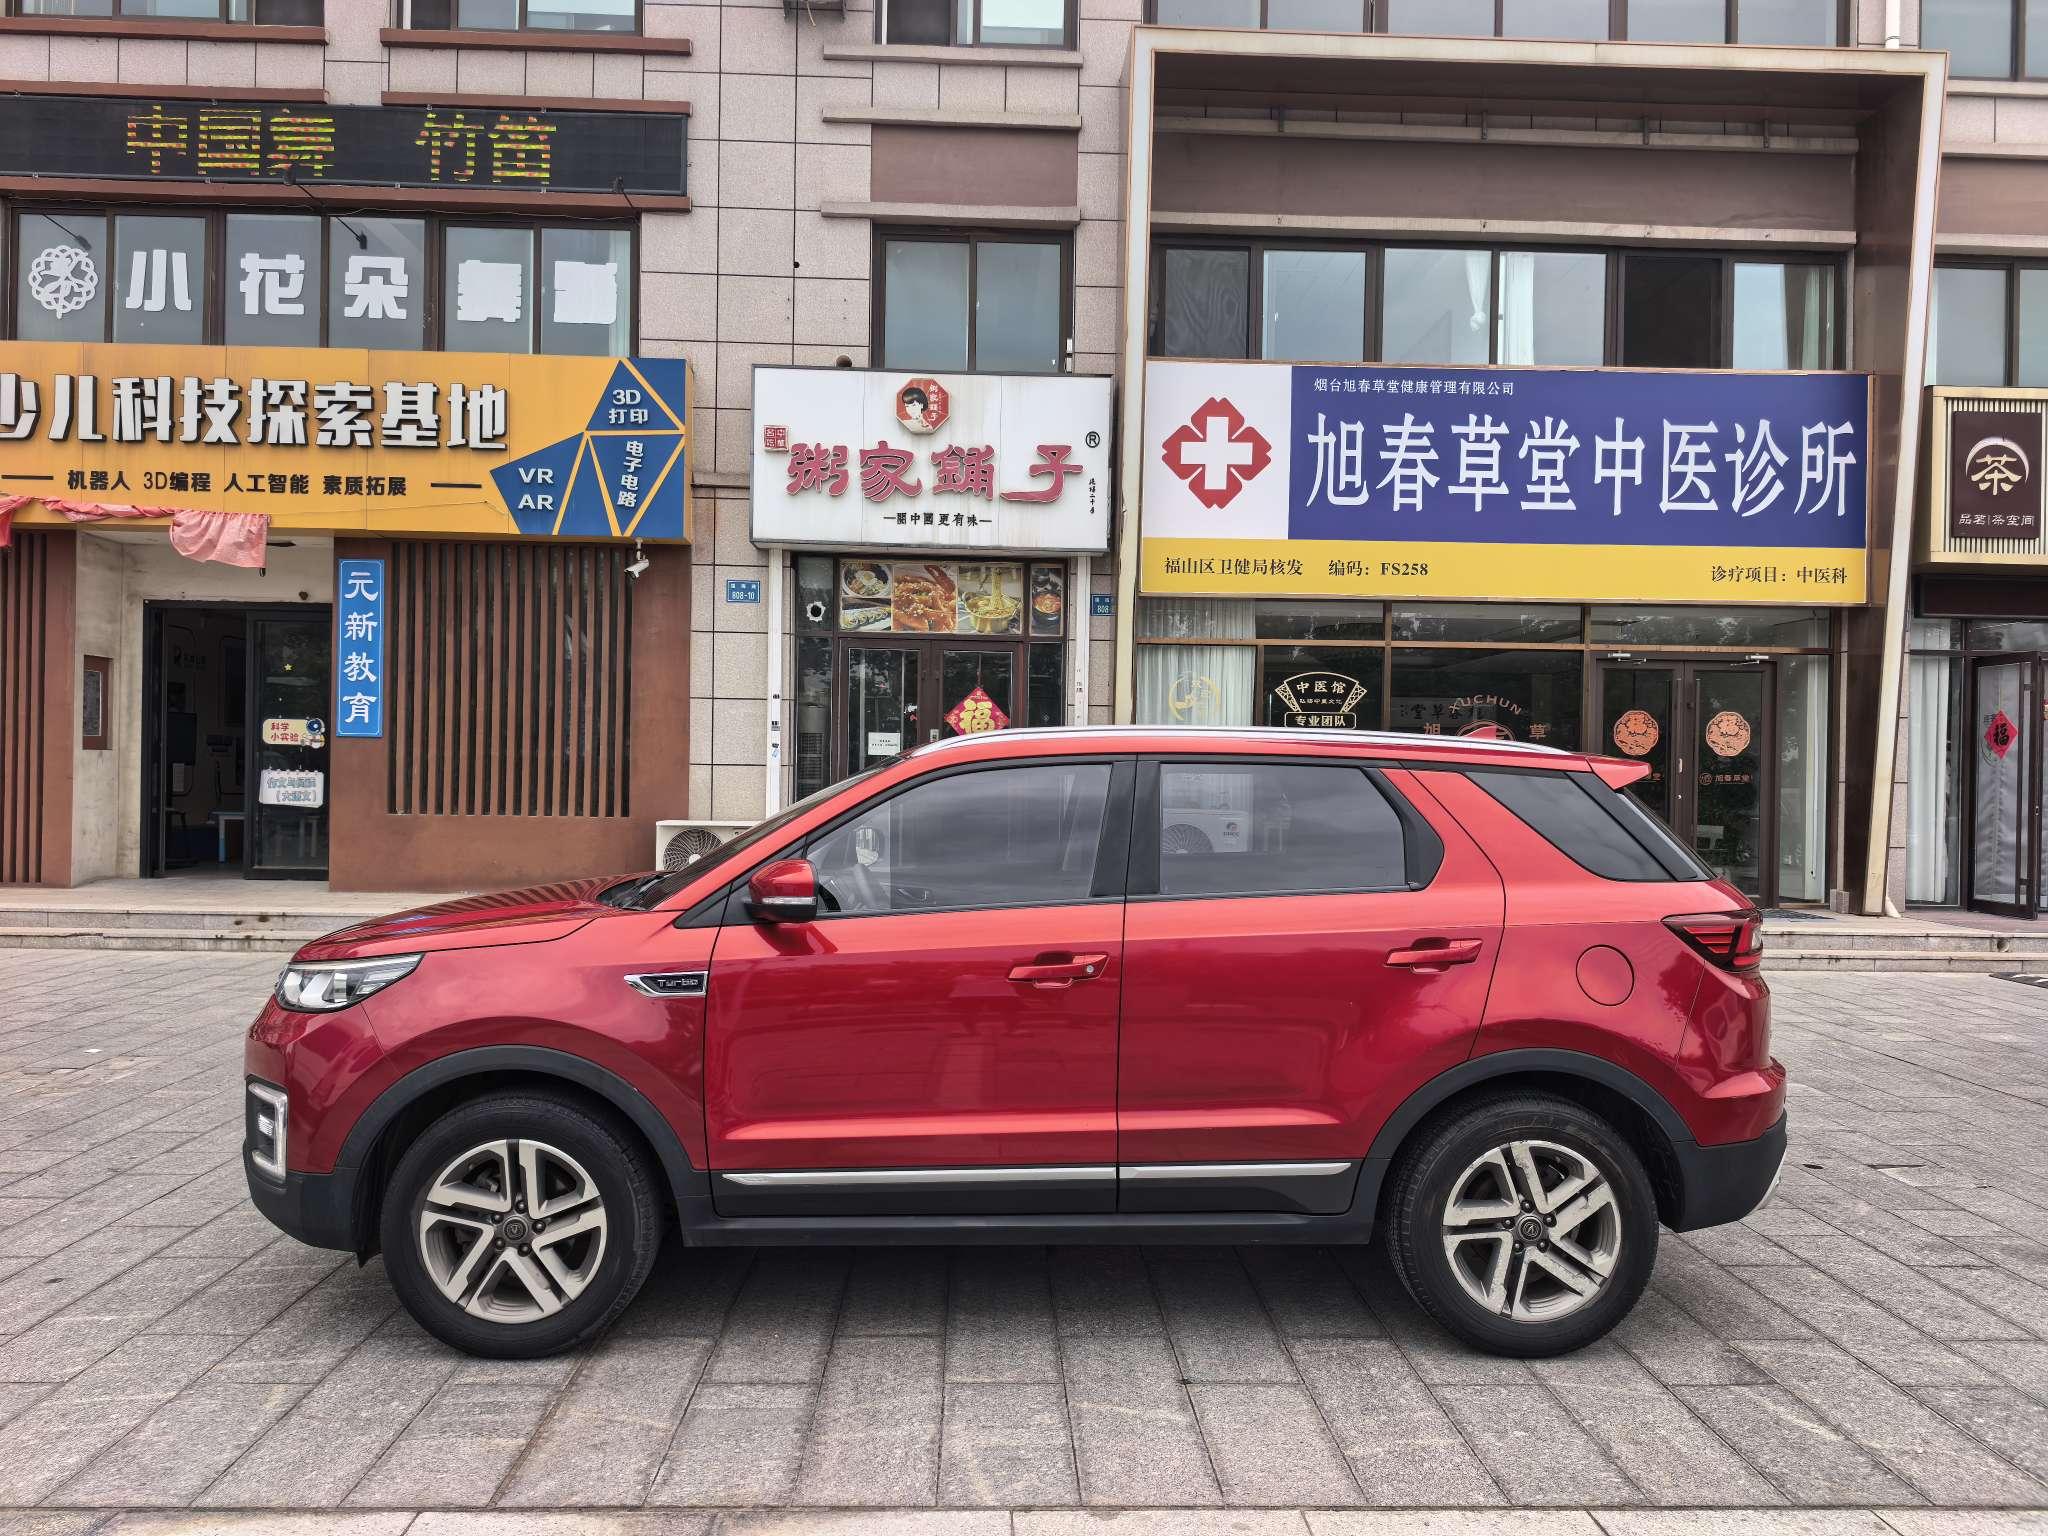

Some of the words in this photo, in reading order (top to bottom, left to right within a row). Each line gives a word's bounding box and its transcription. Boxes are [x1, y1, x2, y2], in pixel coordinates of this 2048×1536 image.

[415, 112, 557, 184] 竹笛
[1314, 378, 1514, 396] 烟台旭春草堂健康管理有限公司
[612, 389, 642, 406] 3D
[608, 408, 649, 425] 打印
[616, 440, 645, 508] 电子电路
[1306, 412, 1857, 517] 旭春草堂中医诊所
[67, 469, 131, 491] 机器人
[143, 471, 212, 493] 3D编程
[224, 473, 310, 496] 人工智能
[322, 474, 407, 497] 素质拓展
[518, 467, 555, 485] VR
[1971, 453, 2022, 496] 茶
[517, 493, 554, 511] AR
[1164, 557, 1304, 577] 福山区卫健局核发
[1380, 562, 1430, 577] FS258
[1711, 565, 1786, 583] 诊疗项目：
[1796, 566, 1848, 584] 中医科
[342, 571, 379, 724] 元新教育
[1296, 680, 1347, 694] 中医馆
[1449, 694, 1523, 716] XUCHUN
[958, 698, 996, 734] 福
[1295, 715, 1346, 727] 专业团队
[1529, 723, 1548, 740] 草
[1993, 722, 2010, 746] 福
[657, 978, 699, 988] Turbo
